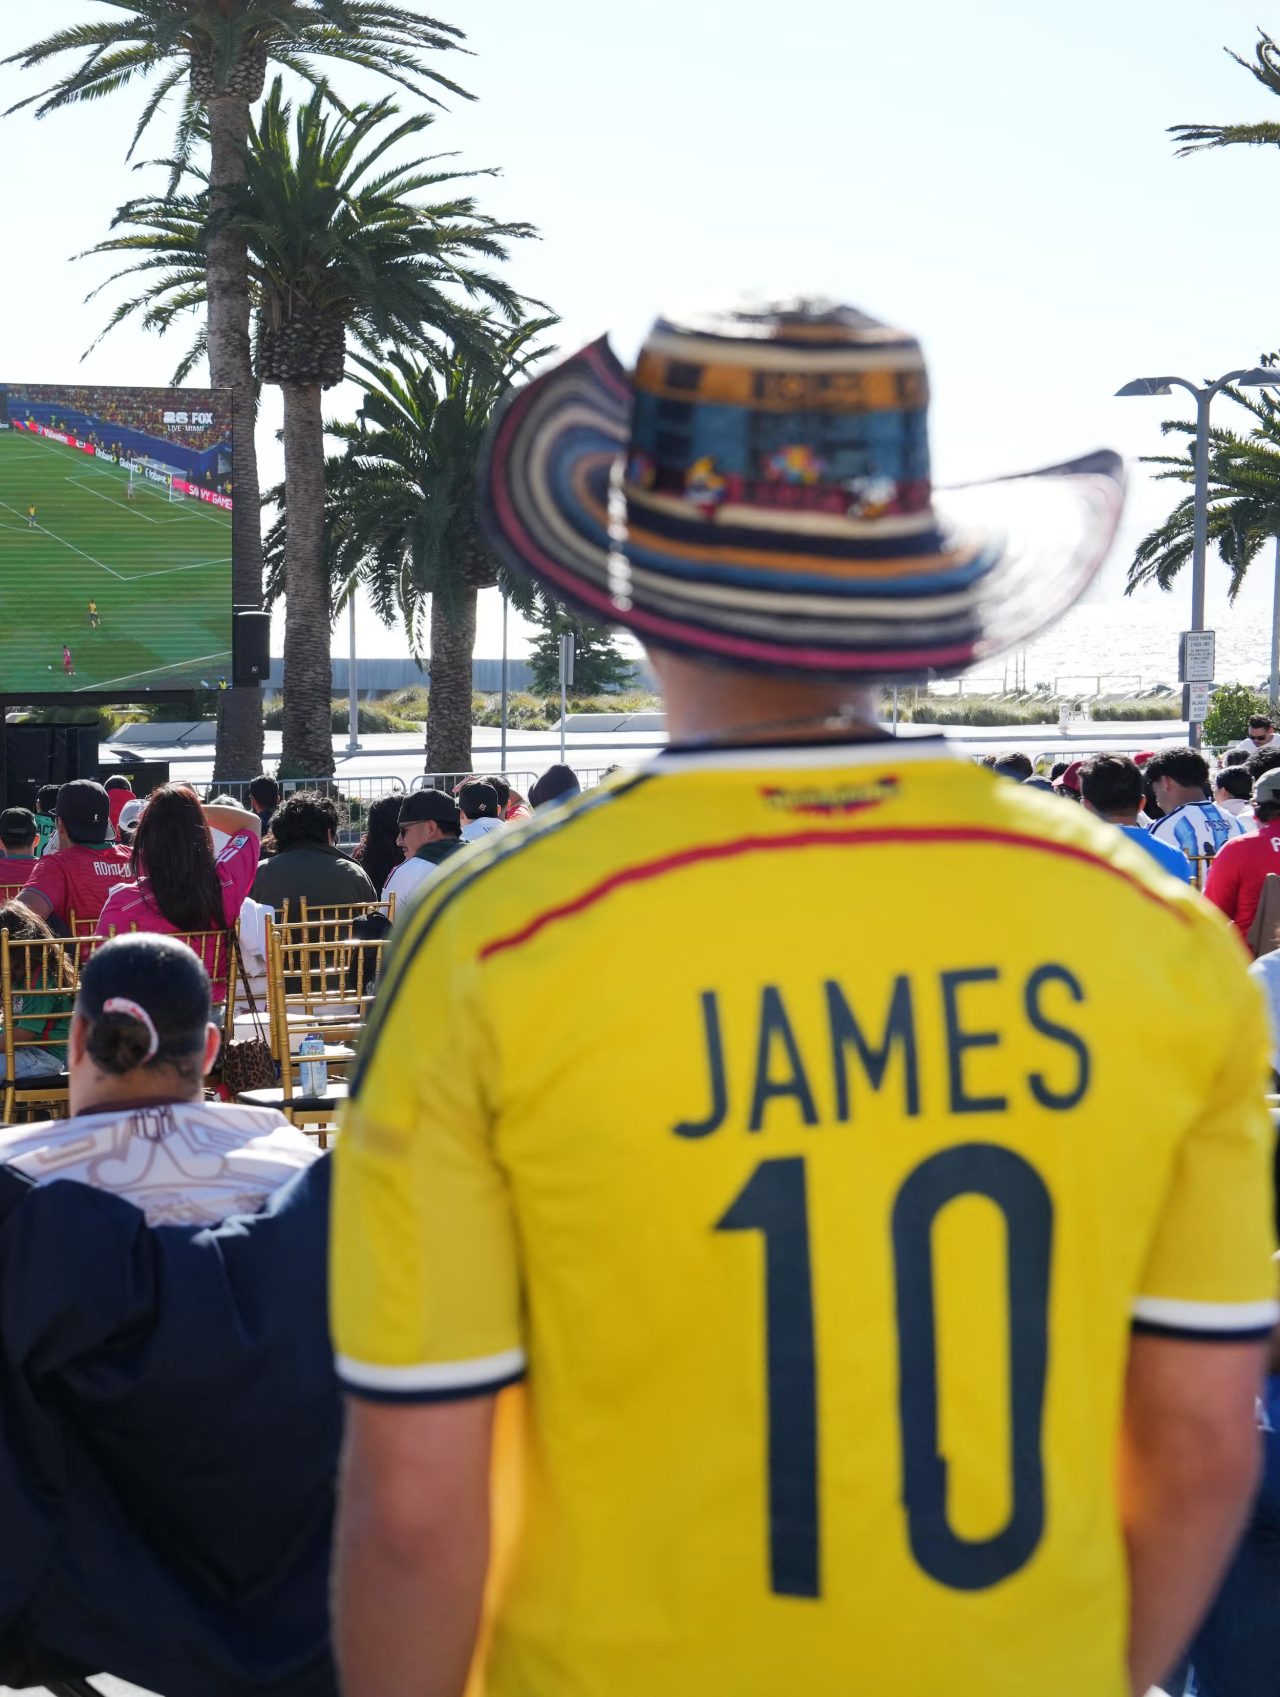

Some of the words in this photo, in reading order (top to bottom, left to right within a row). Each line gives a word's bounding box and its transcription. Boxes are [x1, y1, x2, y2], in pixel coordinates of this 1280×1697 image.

[95, 448, 113, 462] Globant
[192, 412, 213, 424] FOX
[673, 962, 1092, 1140] JAMES
[713, 1142, 1056, 1598] 10
